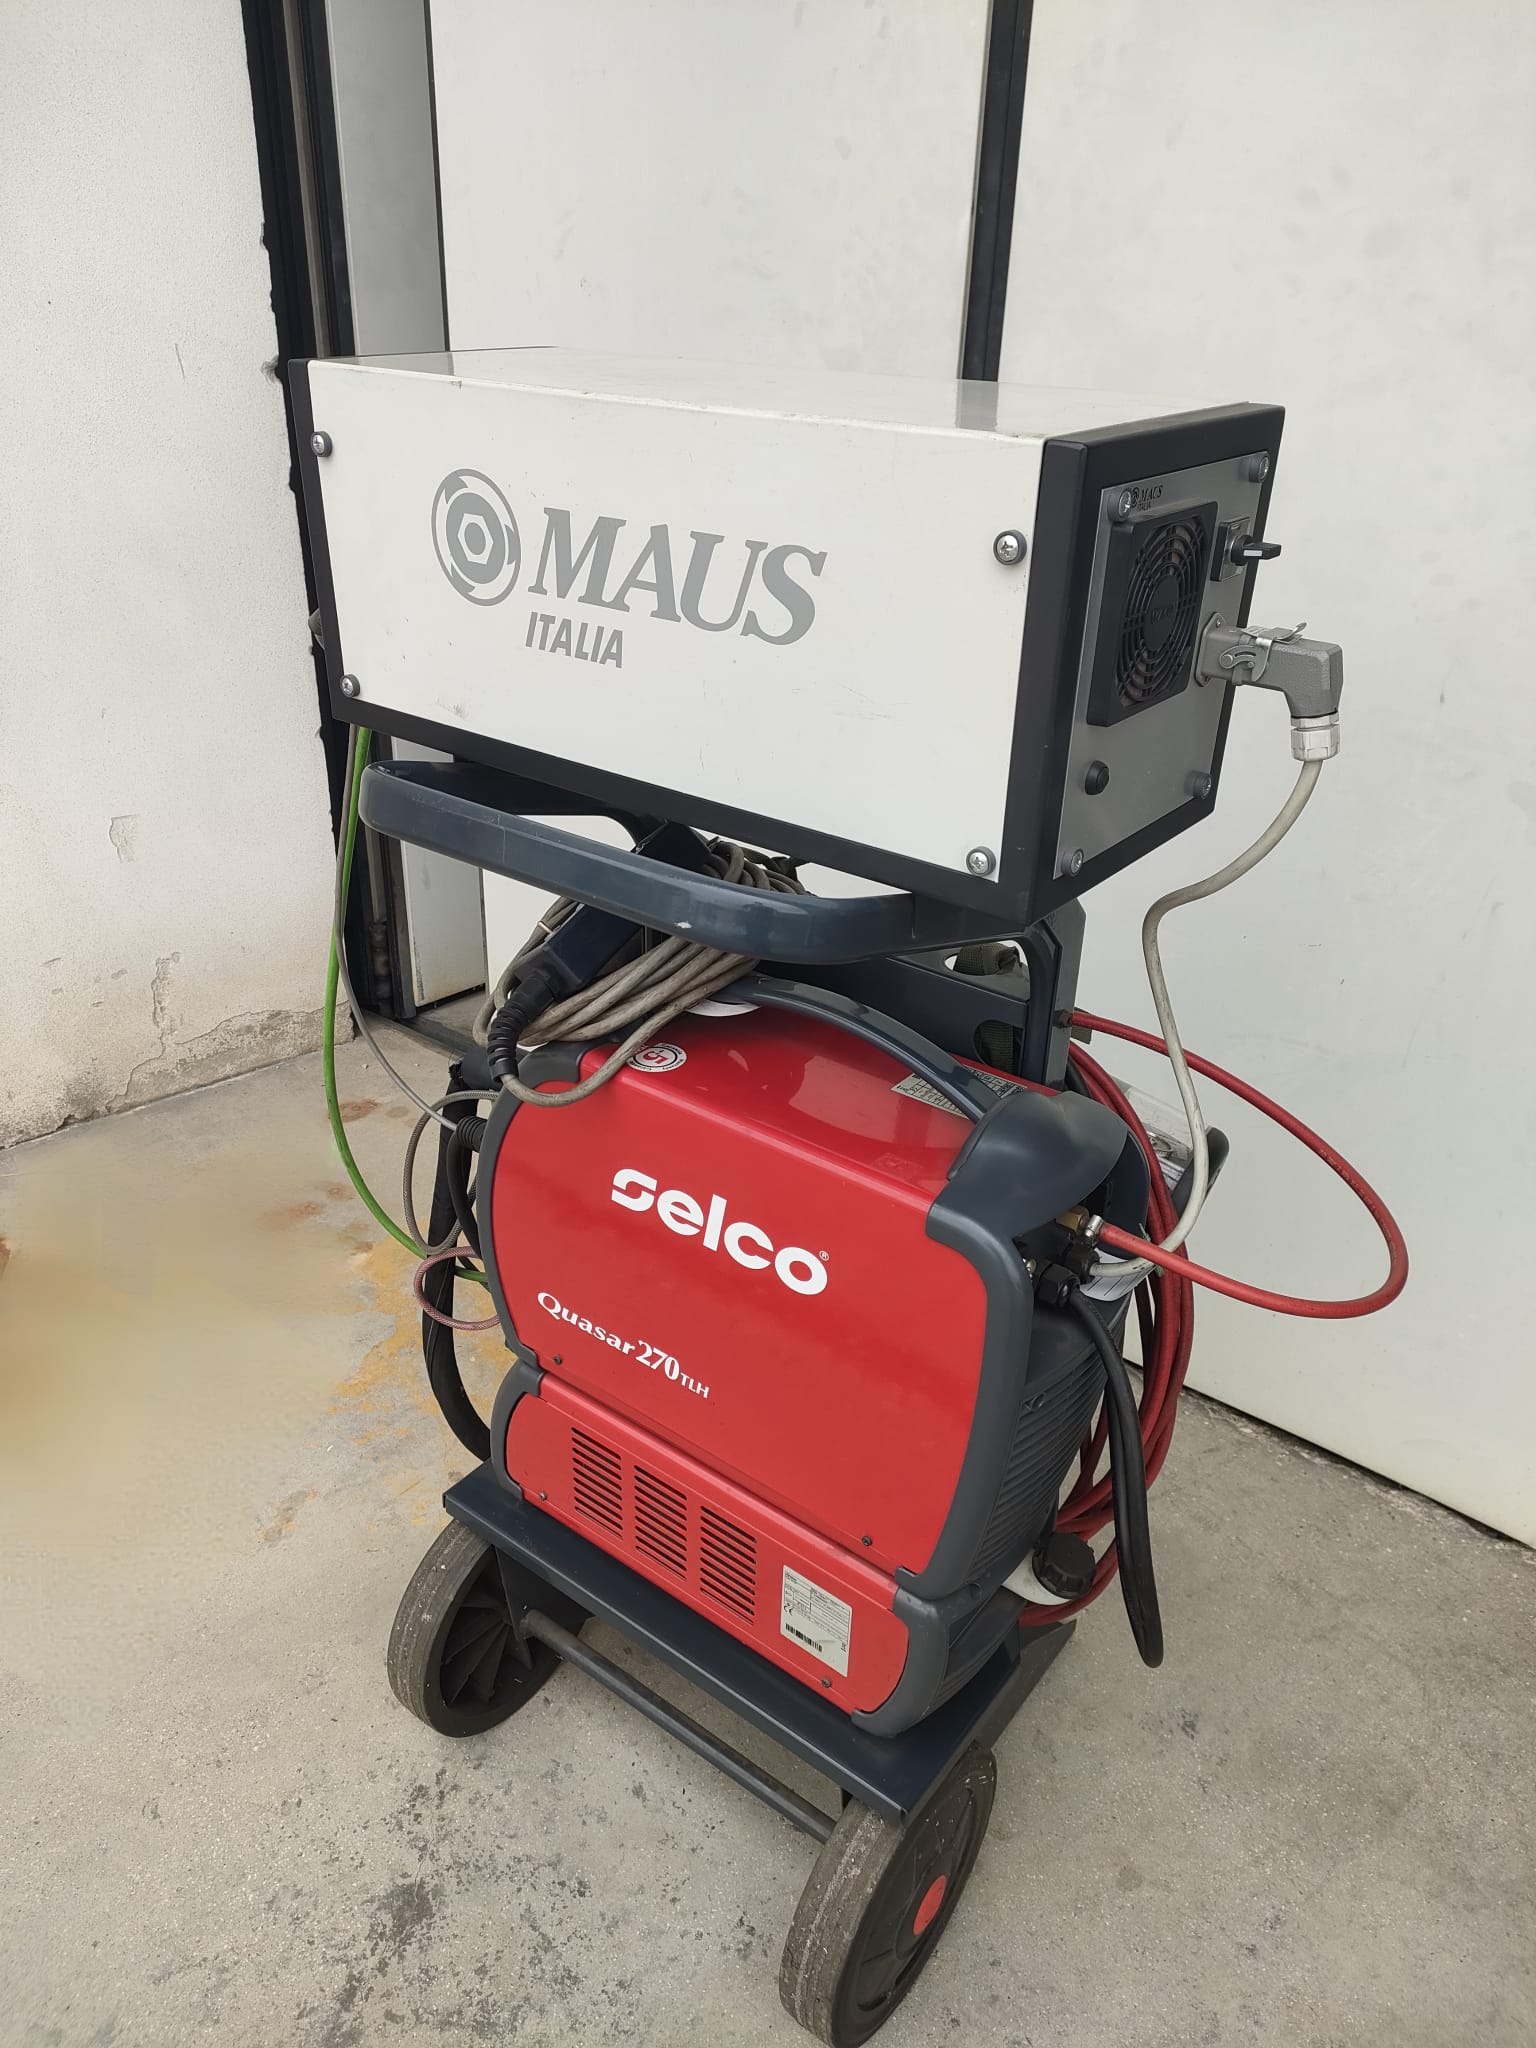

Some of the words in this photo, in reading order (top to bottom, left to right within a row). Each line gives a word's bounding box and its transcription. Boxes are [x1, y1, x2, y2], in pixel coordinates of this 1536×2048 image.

[528, 507, 827, 645] MAUS
[525, 611, 624, 668] ITALIA
[537, 1292, 635, 1355] Quasar
